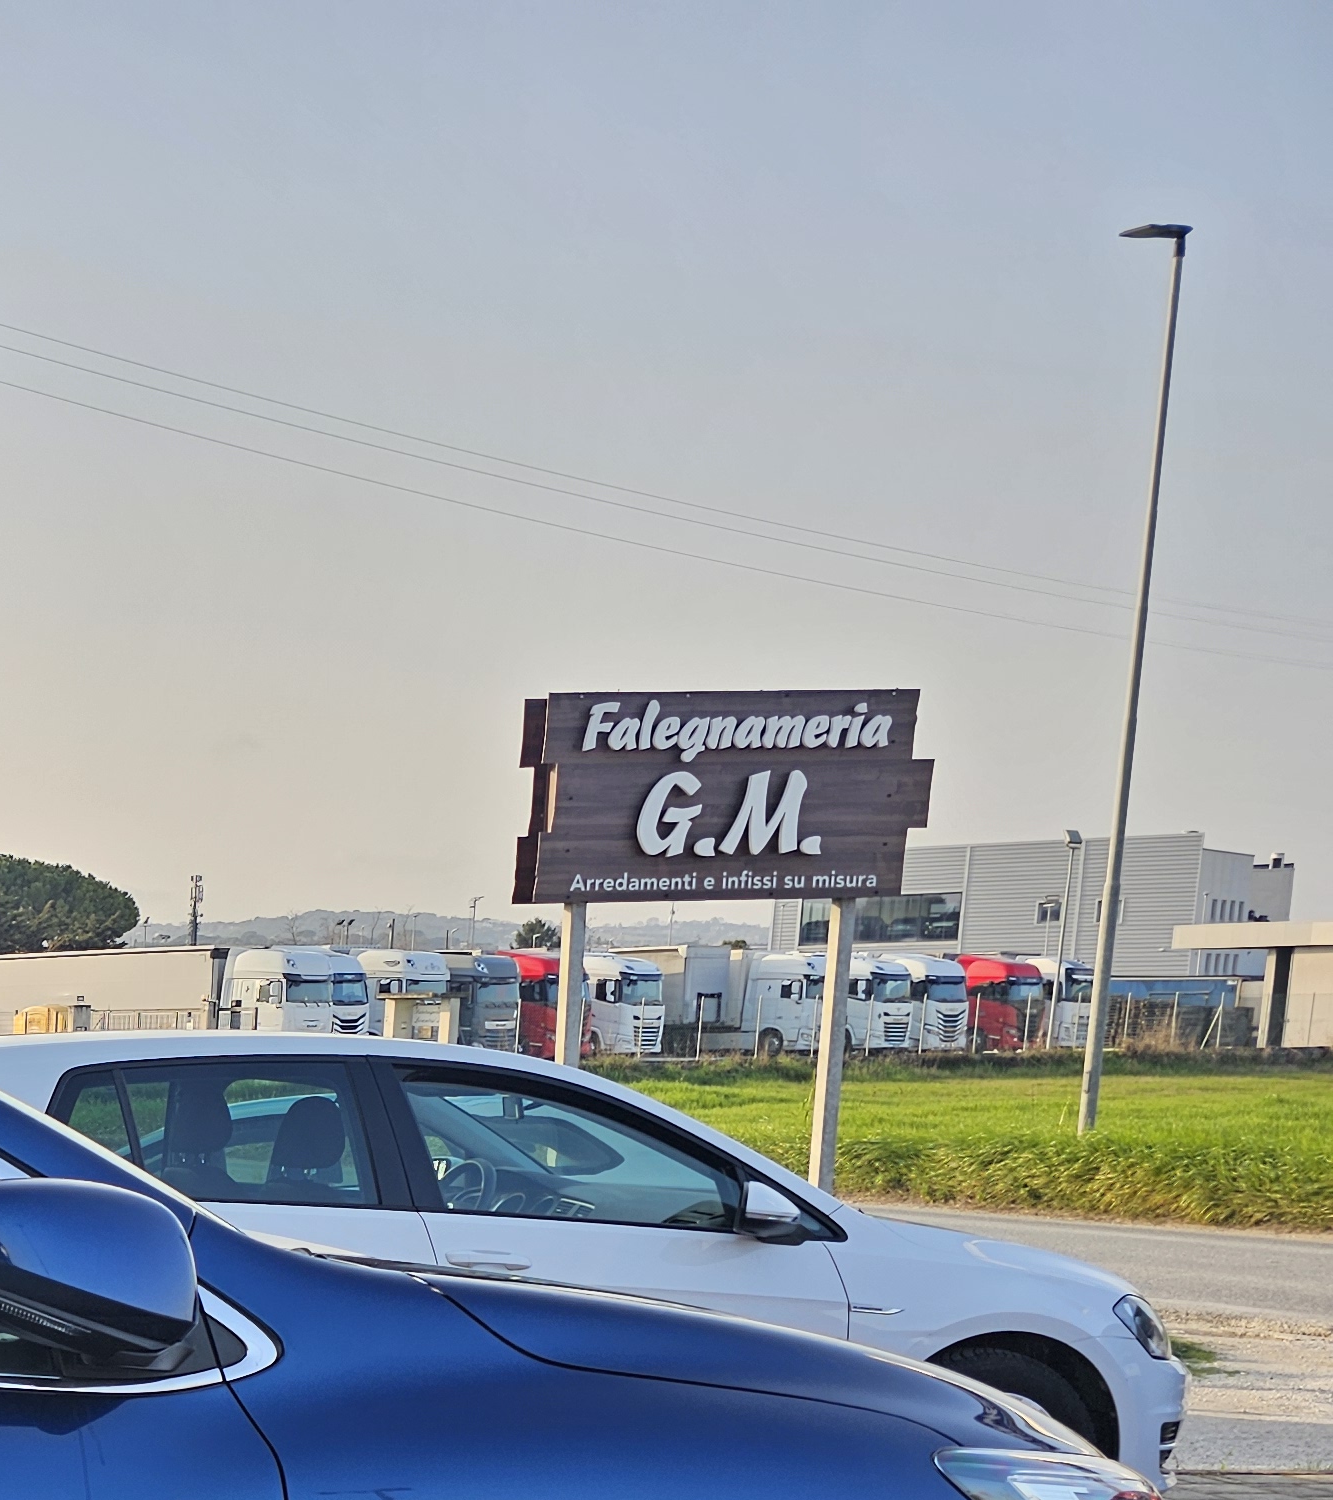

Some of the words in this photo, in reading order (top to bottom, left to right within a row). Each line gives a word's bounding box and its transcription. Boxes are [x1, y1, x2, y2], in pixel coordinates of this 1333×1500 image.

[581, 700, 894, 763] Falegnameria
[636, 769, 822, 858] G.M.
[570, 872, 697, 892] Arredamenti
[703, 876, 715, 890] e
[721, 870, 777, 890] infissi
[784, 874, 806, 889] su
[812, 870, 877, 889] misura
